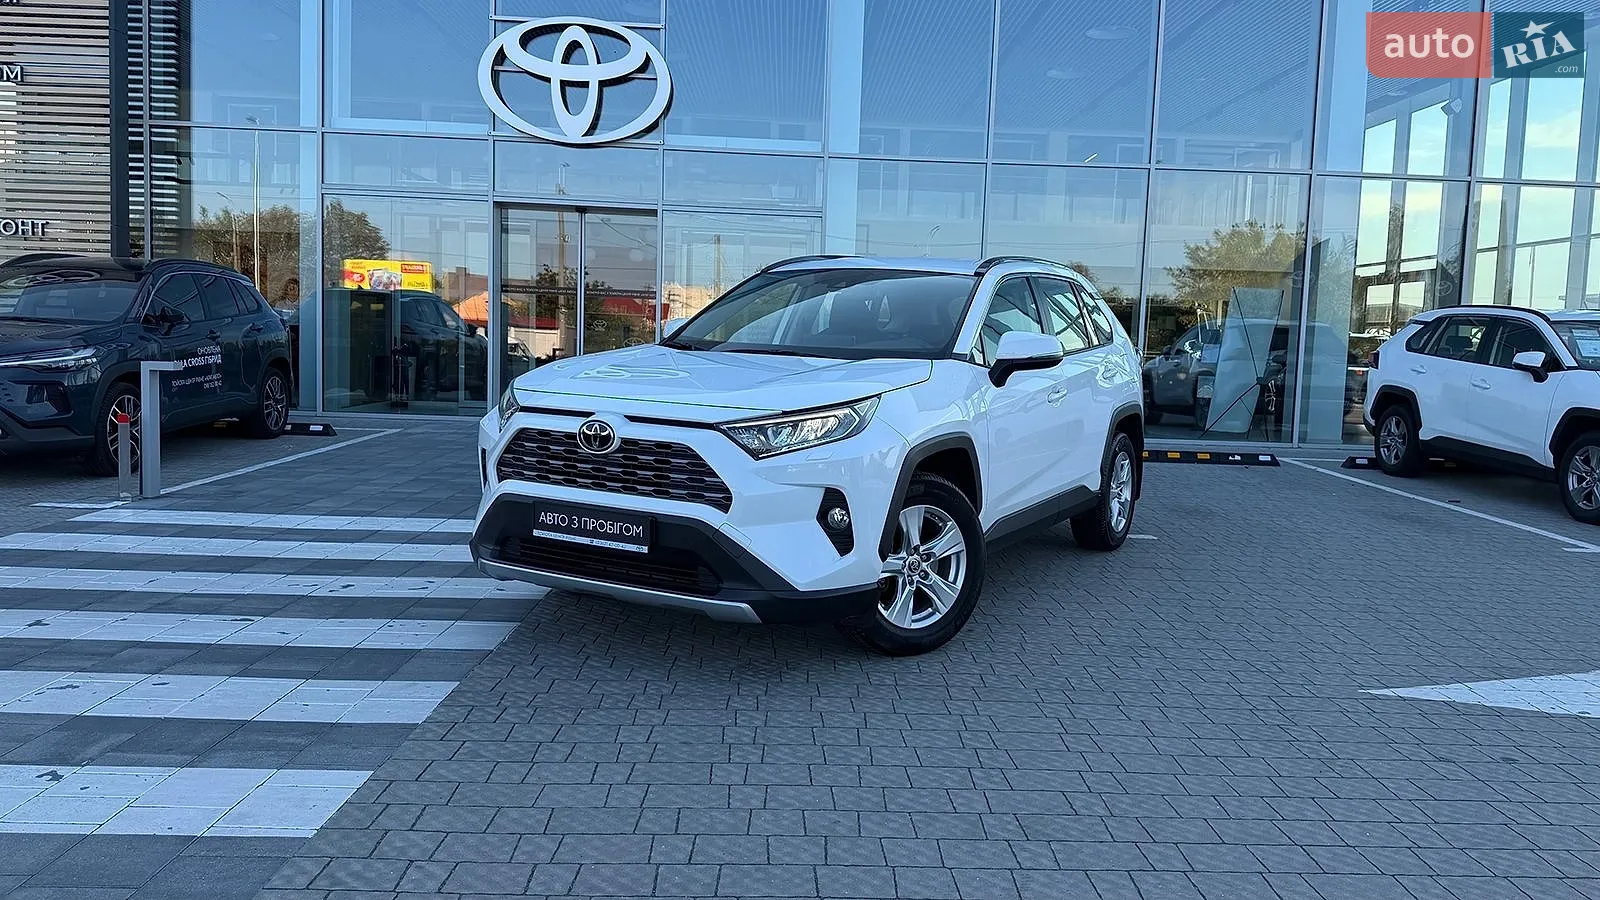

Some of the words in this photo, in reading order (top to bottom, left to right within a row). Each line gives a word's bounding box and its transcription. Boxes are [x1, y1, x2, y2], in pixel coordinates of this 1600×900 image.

[188, 356, 205, 367] CROSS
[538, 511, 569, 527] АВТО
[581, 517, 643, 538] ПРОБІГОМ
